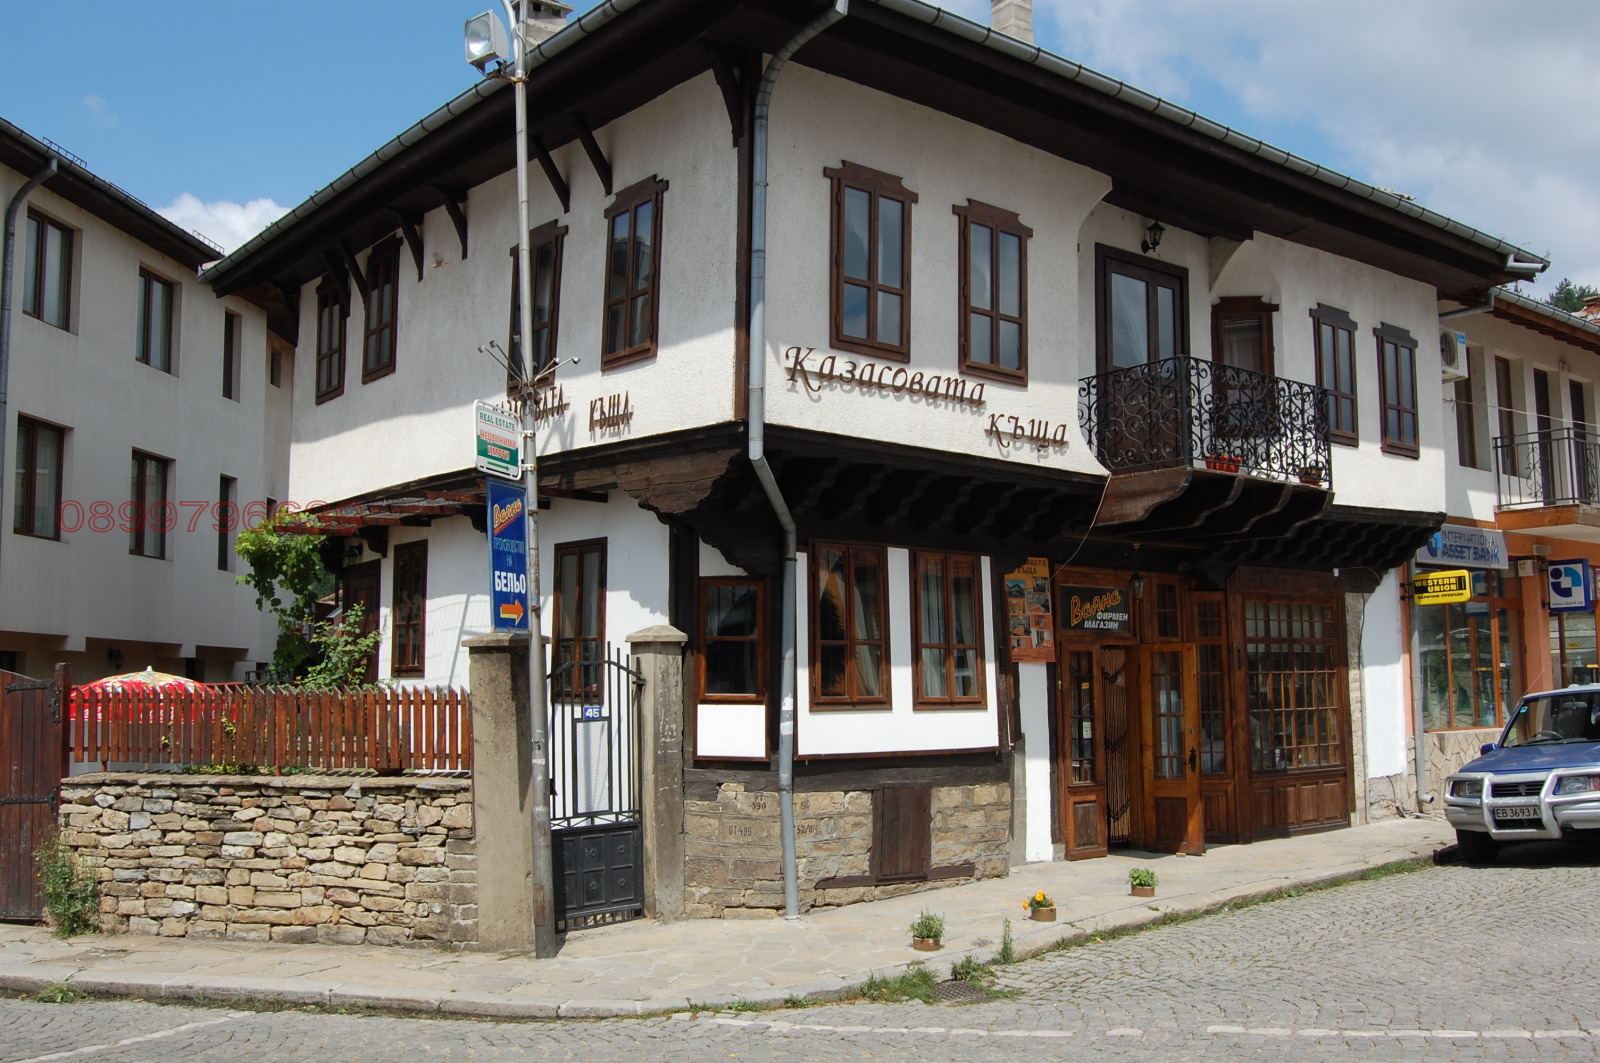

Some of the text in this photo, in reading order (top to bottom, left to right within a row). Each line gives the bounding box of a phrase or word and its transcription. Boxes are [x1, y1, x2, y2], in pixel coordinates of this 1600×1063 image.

[785, 346, 986, 405] Казасовата
[589, 390, 630, 432] КЪЩА
[479, 411, 516, 432] REAL ESTATE
[1441, 530, 1499, 548] INTERNATIONAL
[1441, 543, 1500, 565] ASSET BANK
[506, 555, 513, 567] НА
[495, 570, 526, 594] БЕЛЬО
[1415, 577, 1457, 587] WESTERN
[1427, 584, 1457, 593] UNION
[1096, 611, 1129, 621] ФИРМЕН
[1084, 620, 1119, 629] МАГАЗИН
[585, 708, 600, 718] 45
[1496, 809, 1507, 817] EB
[1509, 808, 1530, 817] 3693
